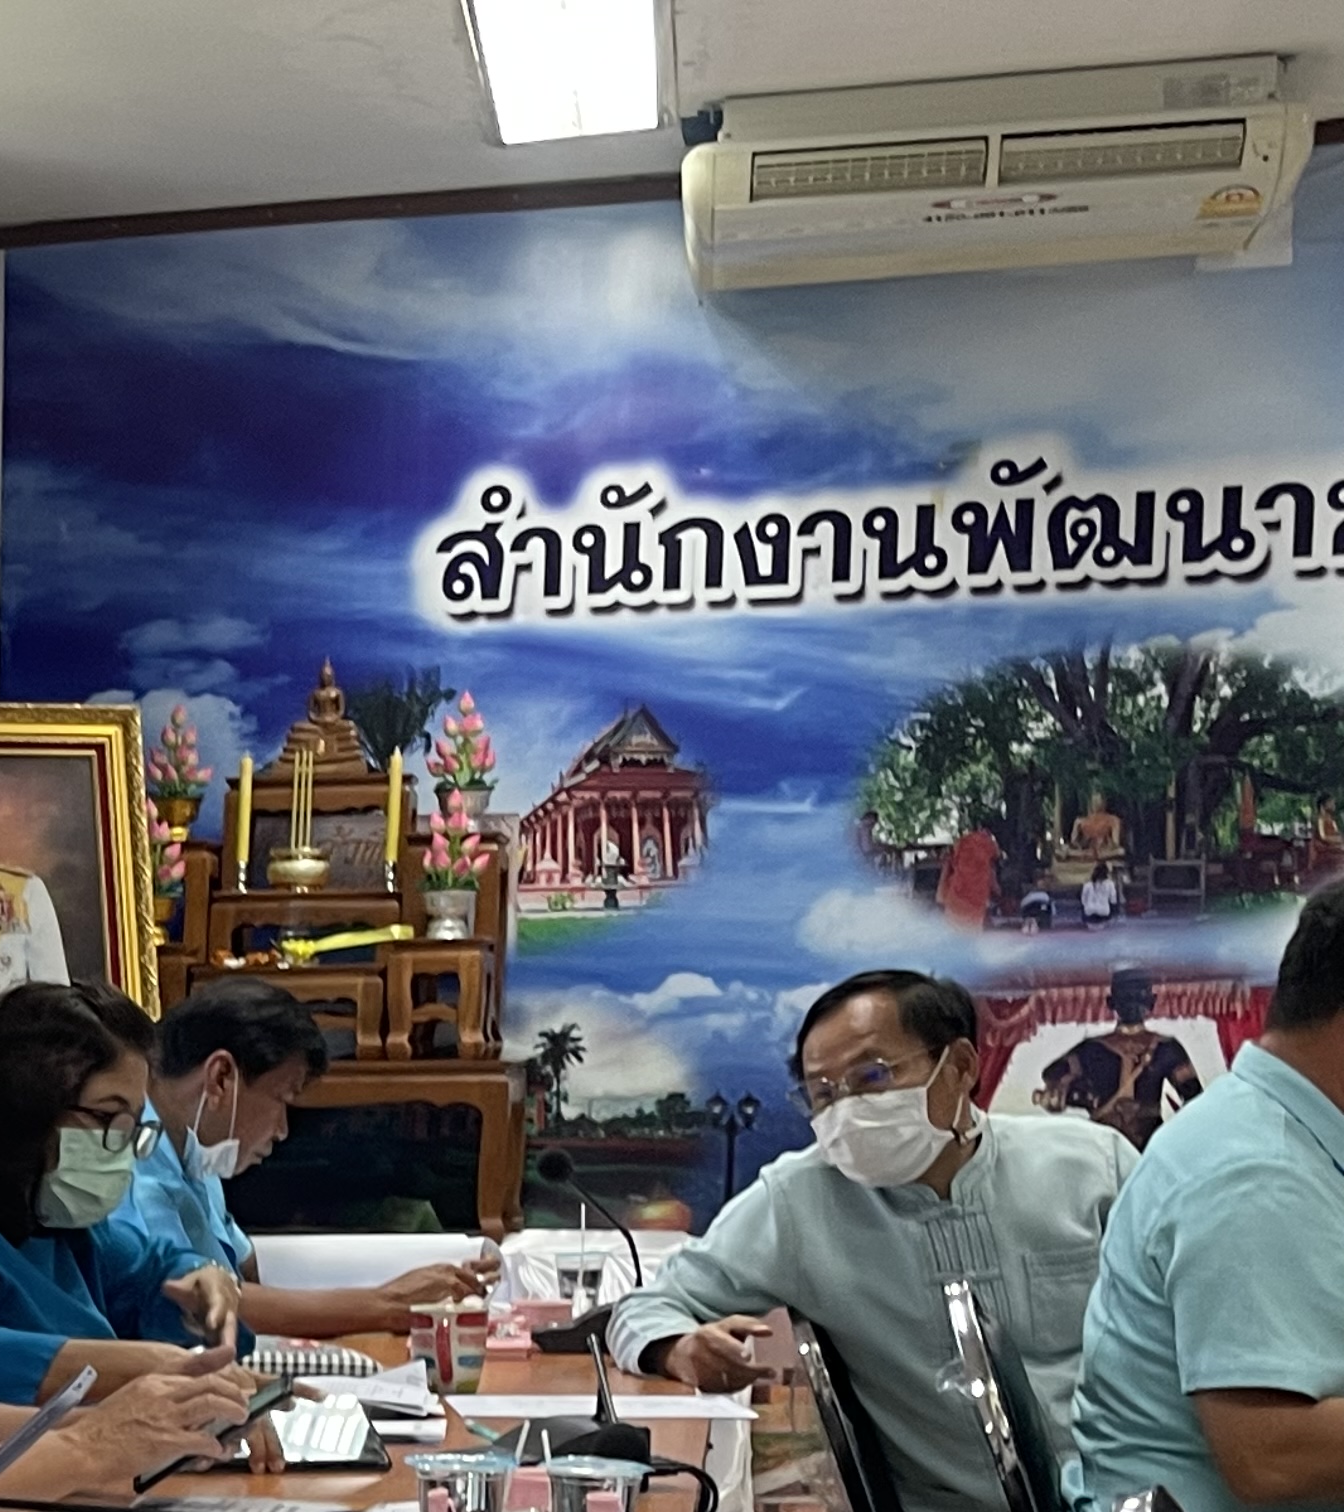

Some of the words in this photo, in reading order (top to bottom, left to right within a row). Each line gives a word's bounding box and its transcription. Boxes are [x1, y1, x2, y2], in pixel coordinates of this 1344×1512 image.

[434, 455, 1344, 606] สำนักงานพัฒนา
